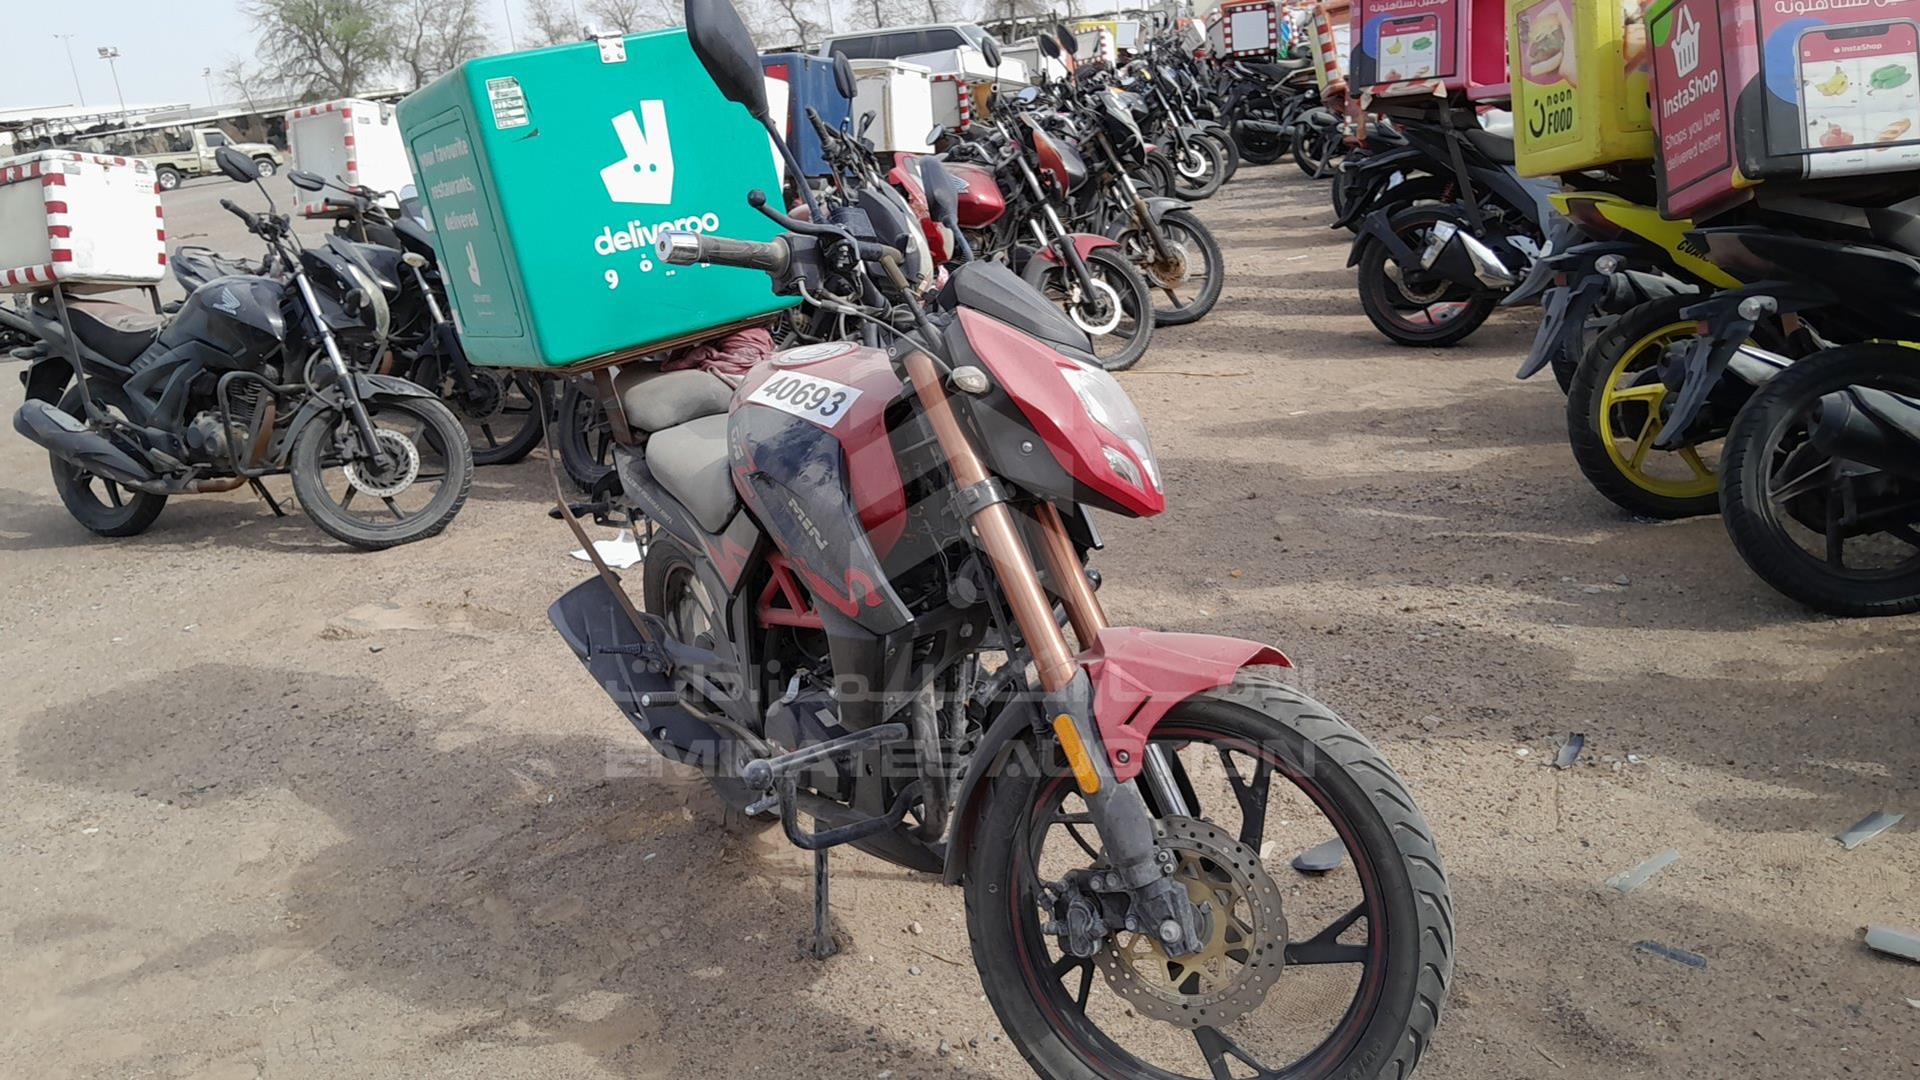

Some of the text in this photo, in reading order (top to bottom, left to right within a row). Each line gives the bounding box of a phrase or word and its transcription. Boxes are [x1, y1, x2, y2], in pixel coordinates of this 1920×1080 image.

[1841, 43, 1883, 53] InstaShop
[1546, 88, 1573, 107] noon
[1663, 69, 1719, 118] InstaShop
[1547, 106, 1573, 135] FOOD
[1665, 108, 1721, 150] Shops you love
[1666, 132, 1721, 171] delivered better
[444, 207, 479, 231] delivered
[763, 376, 847, 417] 40693
